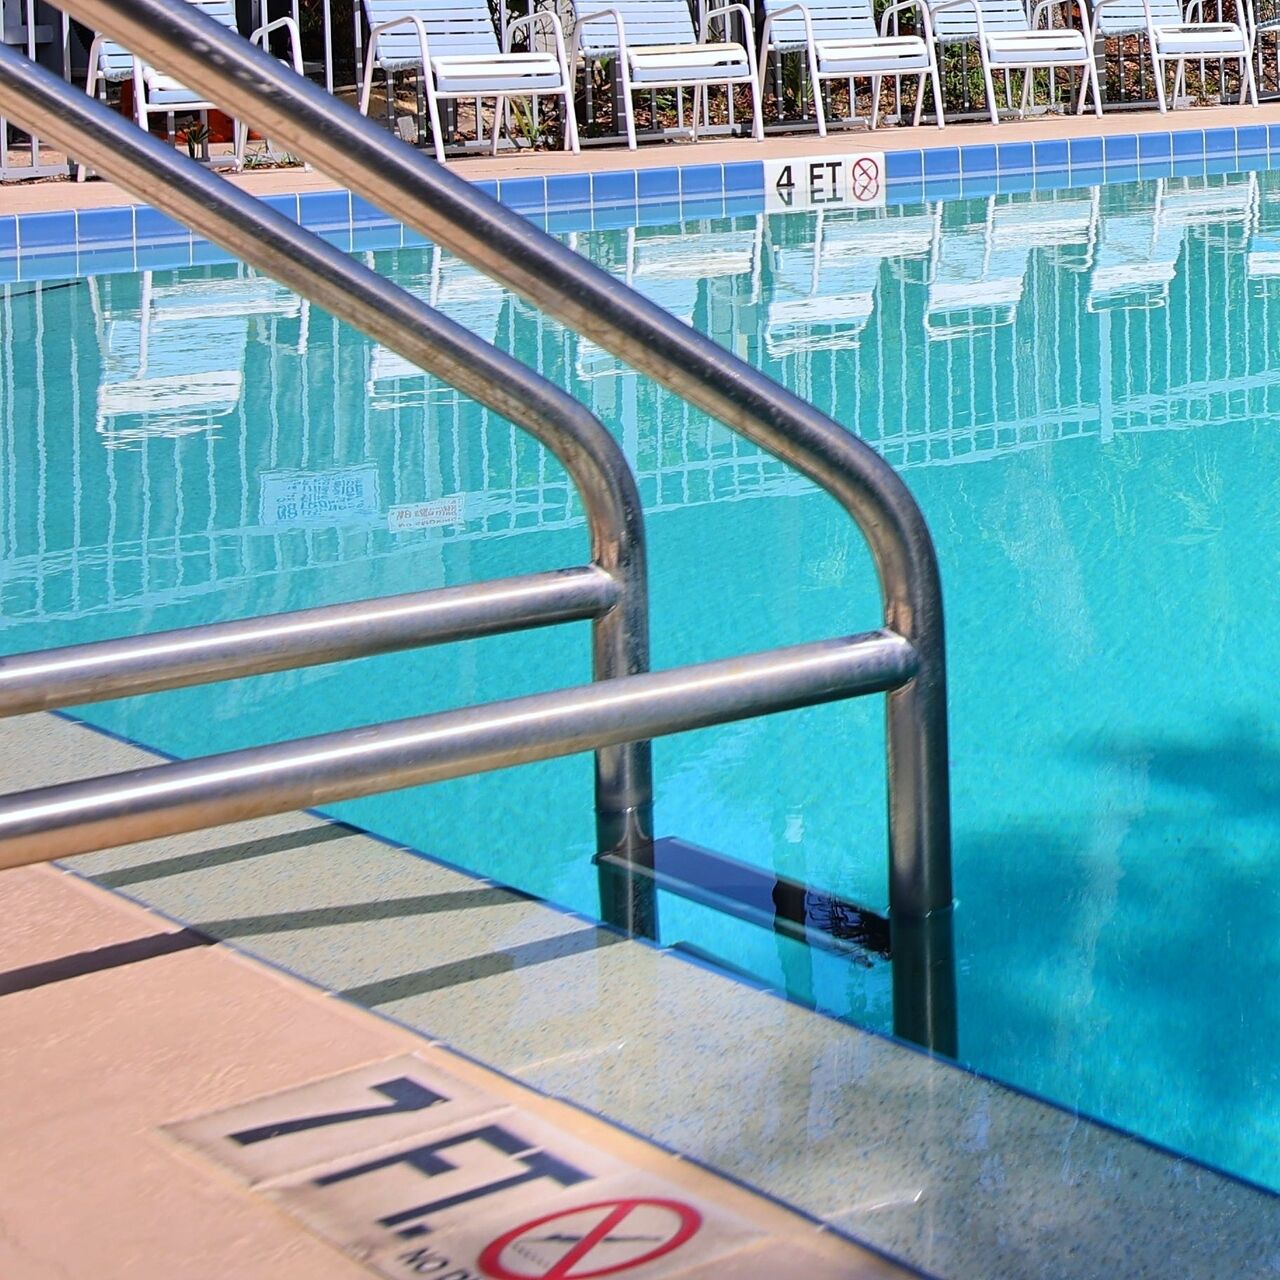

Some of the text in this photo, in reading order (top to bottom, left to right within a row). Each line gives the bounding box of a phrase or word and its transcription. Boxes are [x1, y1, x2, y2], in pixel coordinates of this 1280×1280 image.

[776, 161, 842, 187] 4 FT
[226, 1076, 451, 1146] 7
[398, 1246, 449, 1273] NO
